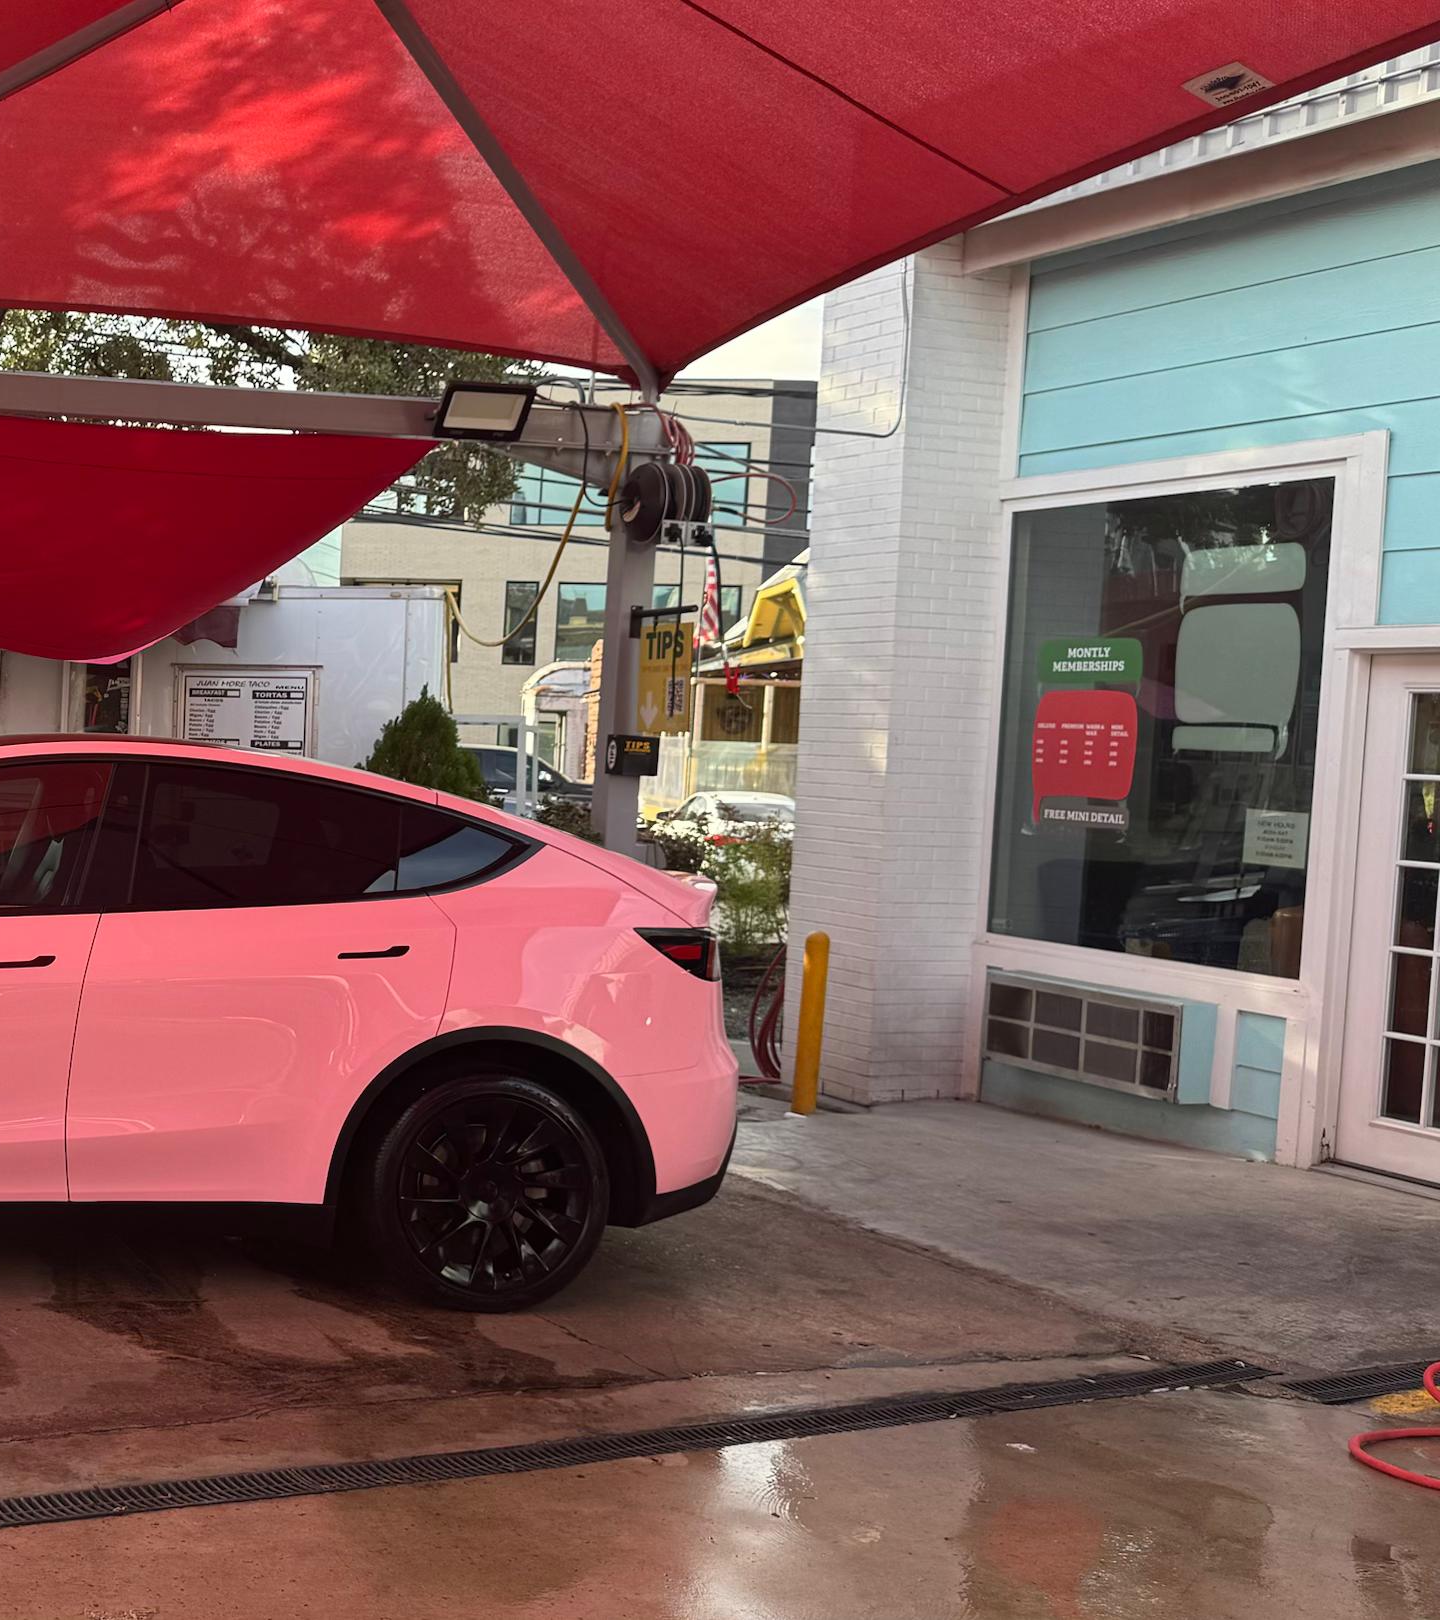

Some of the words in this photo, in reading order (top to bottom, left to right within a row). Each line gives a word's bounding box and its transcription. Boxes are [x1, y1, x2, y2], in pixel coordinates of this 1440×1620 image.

[646, 630, 685, 660] TIPS
[1067, 646, 1111, 658] MONTLY
[1052, 660, 1125, 672] MEMBERSHIPS
[221, 680, 246, 688] MORE
[249, 680, 271, 688] TACO
[254, 691, 288, 699] TORTAS
[625, 740, 651, 750] TIPS
[1043, 808, 1066, 820] FREE
[1067, 810, 1089, 822] MINI
[1090, 811, 1125, 825] DETAIL
